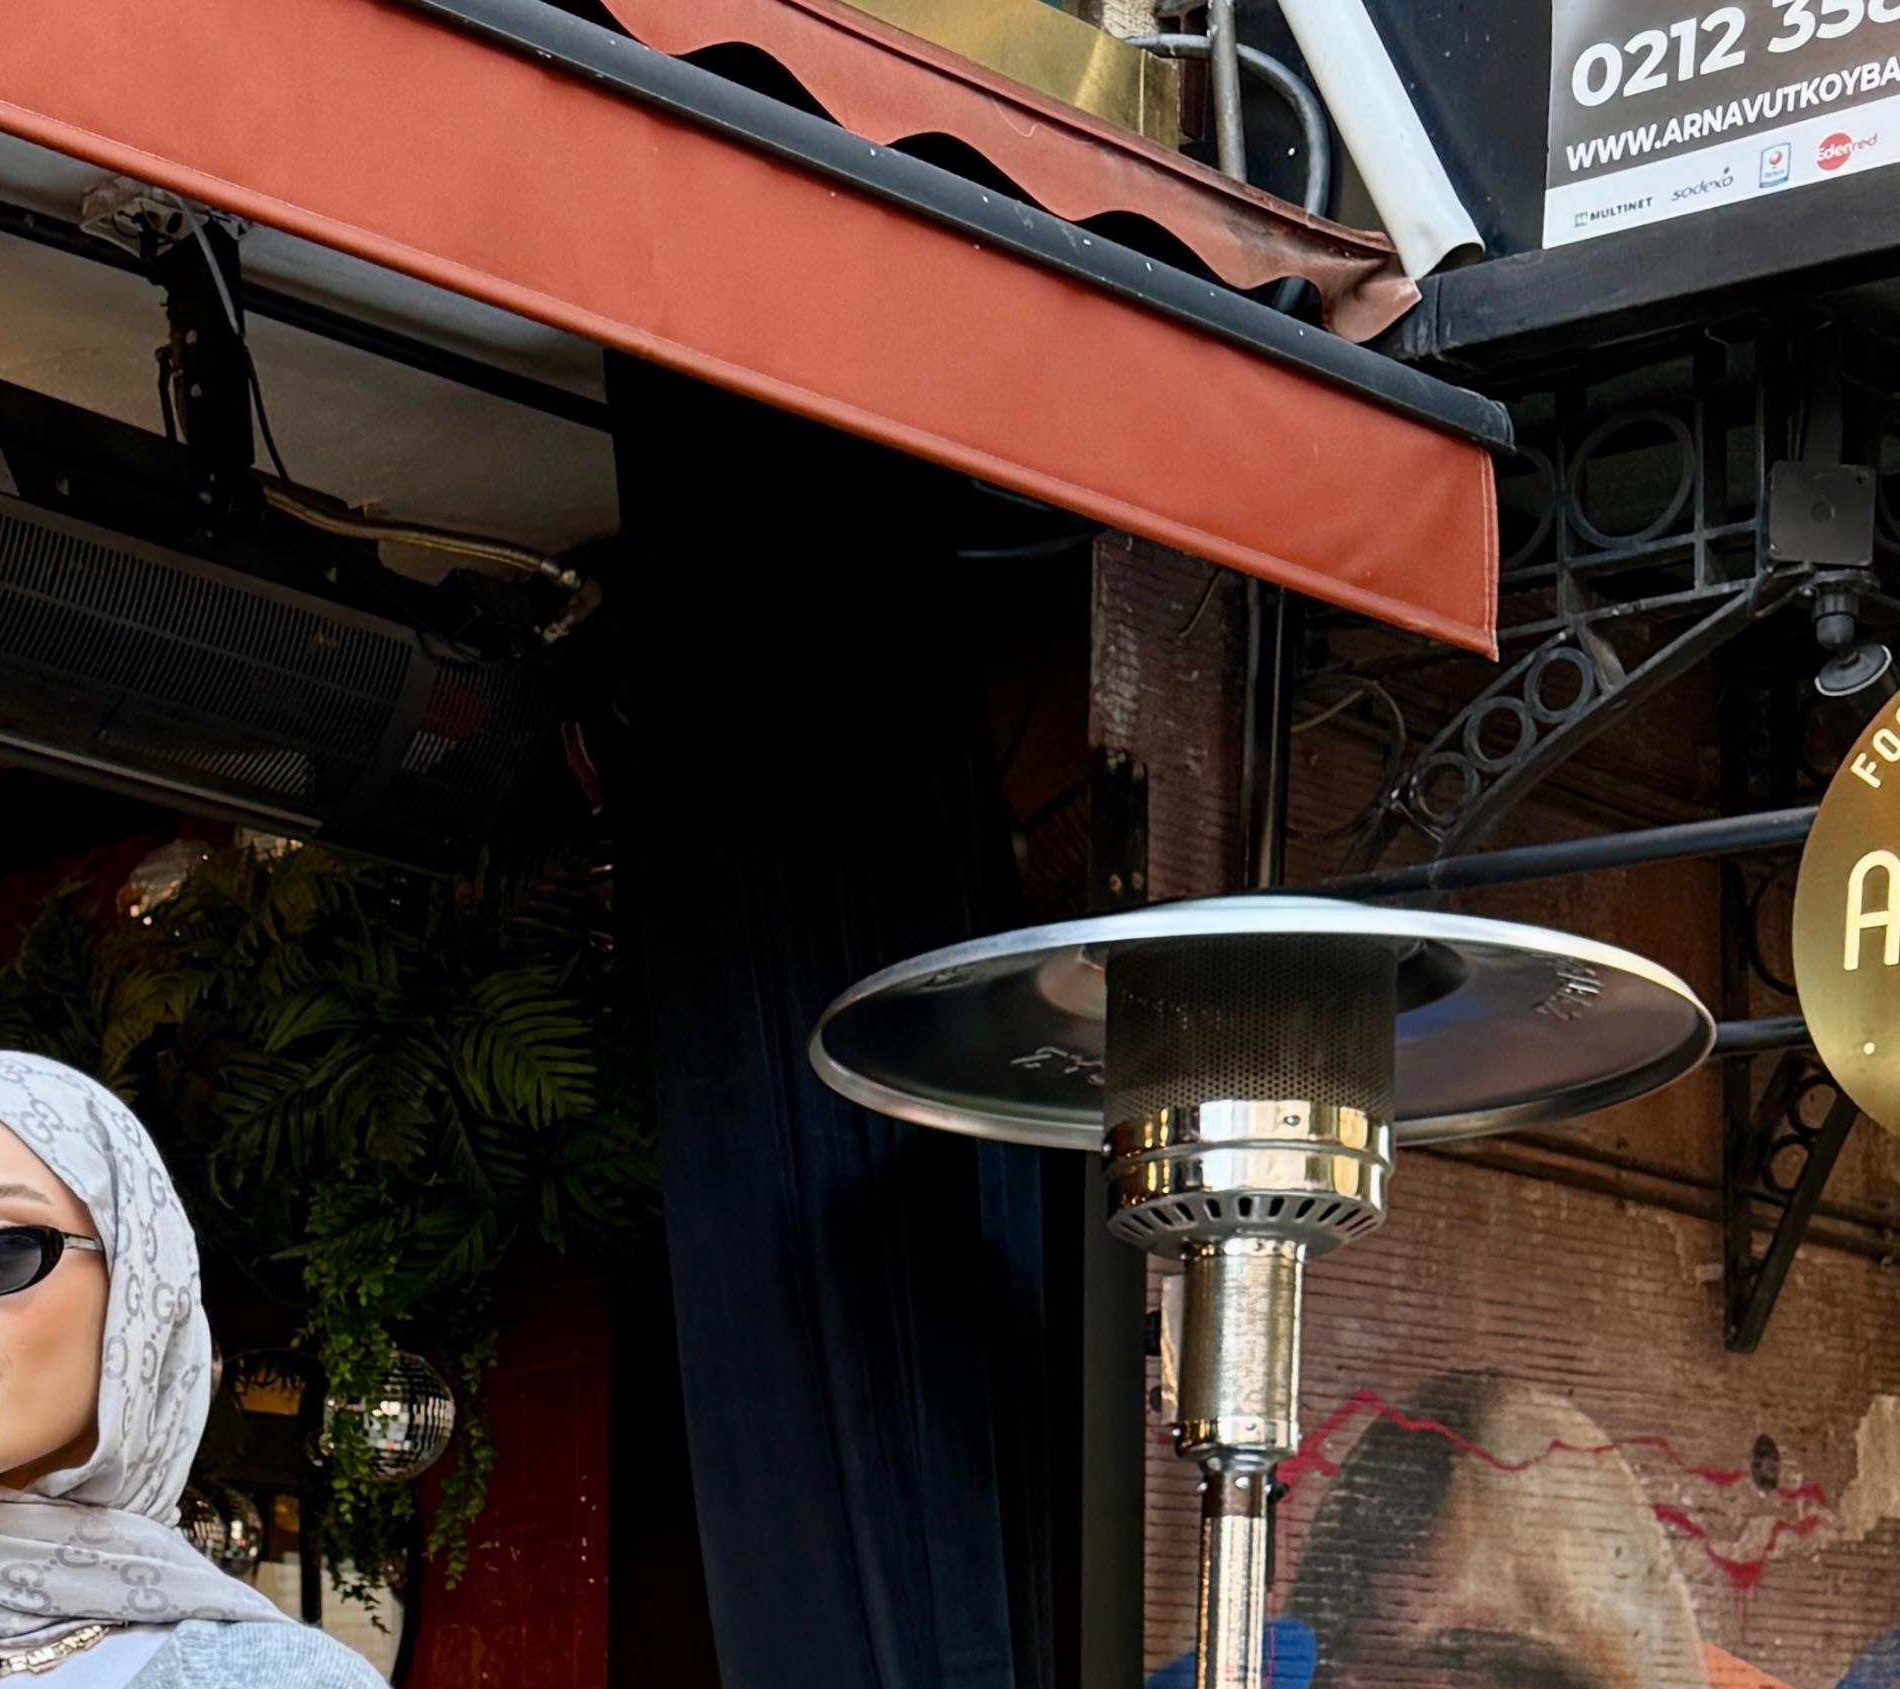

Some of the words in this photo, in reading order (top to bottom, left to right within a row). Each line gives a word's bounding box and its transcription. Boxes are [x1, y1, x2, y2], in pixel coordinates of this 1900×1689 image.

[1571, 6, 1746, 107] 0212
[1589, 197, 1653, 222] MULTINET
[1850, 706, 1900, 789] FO
